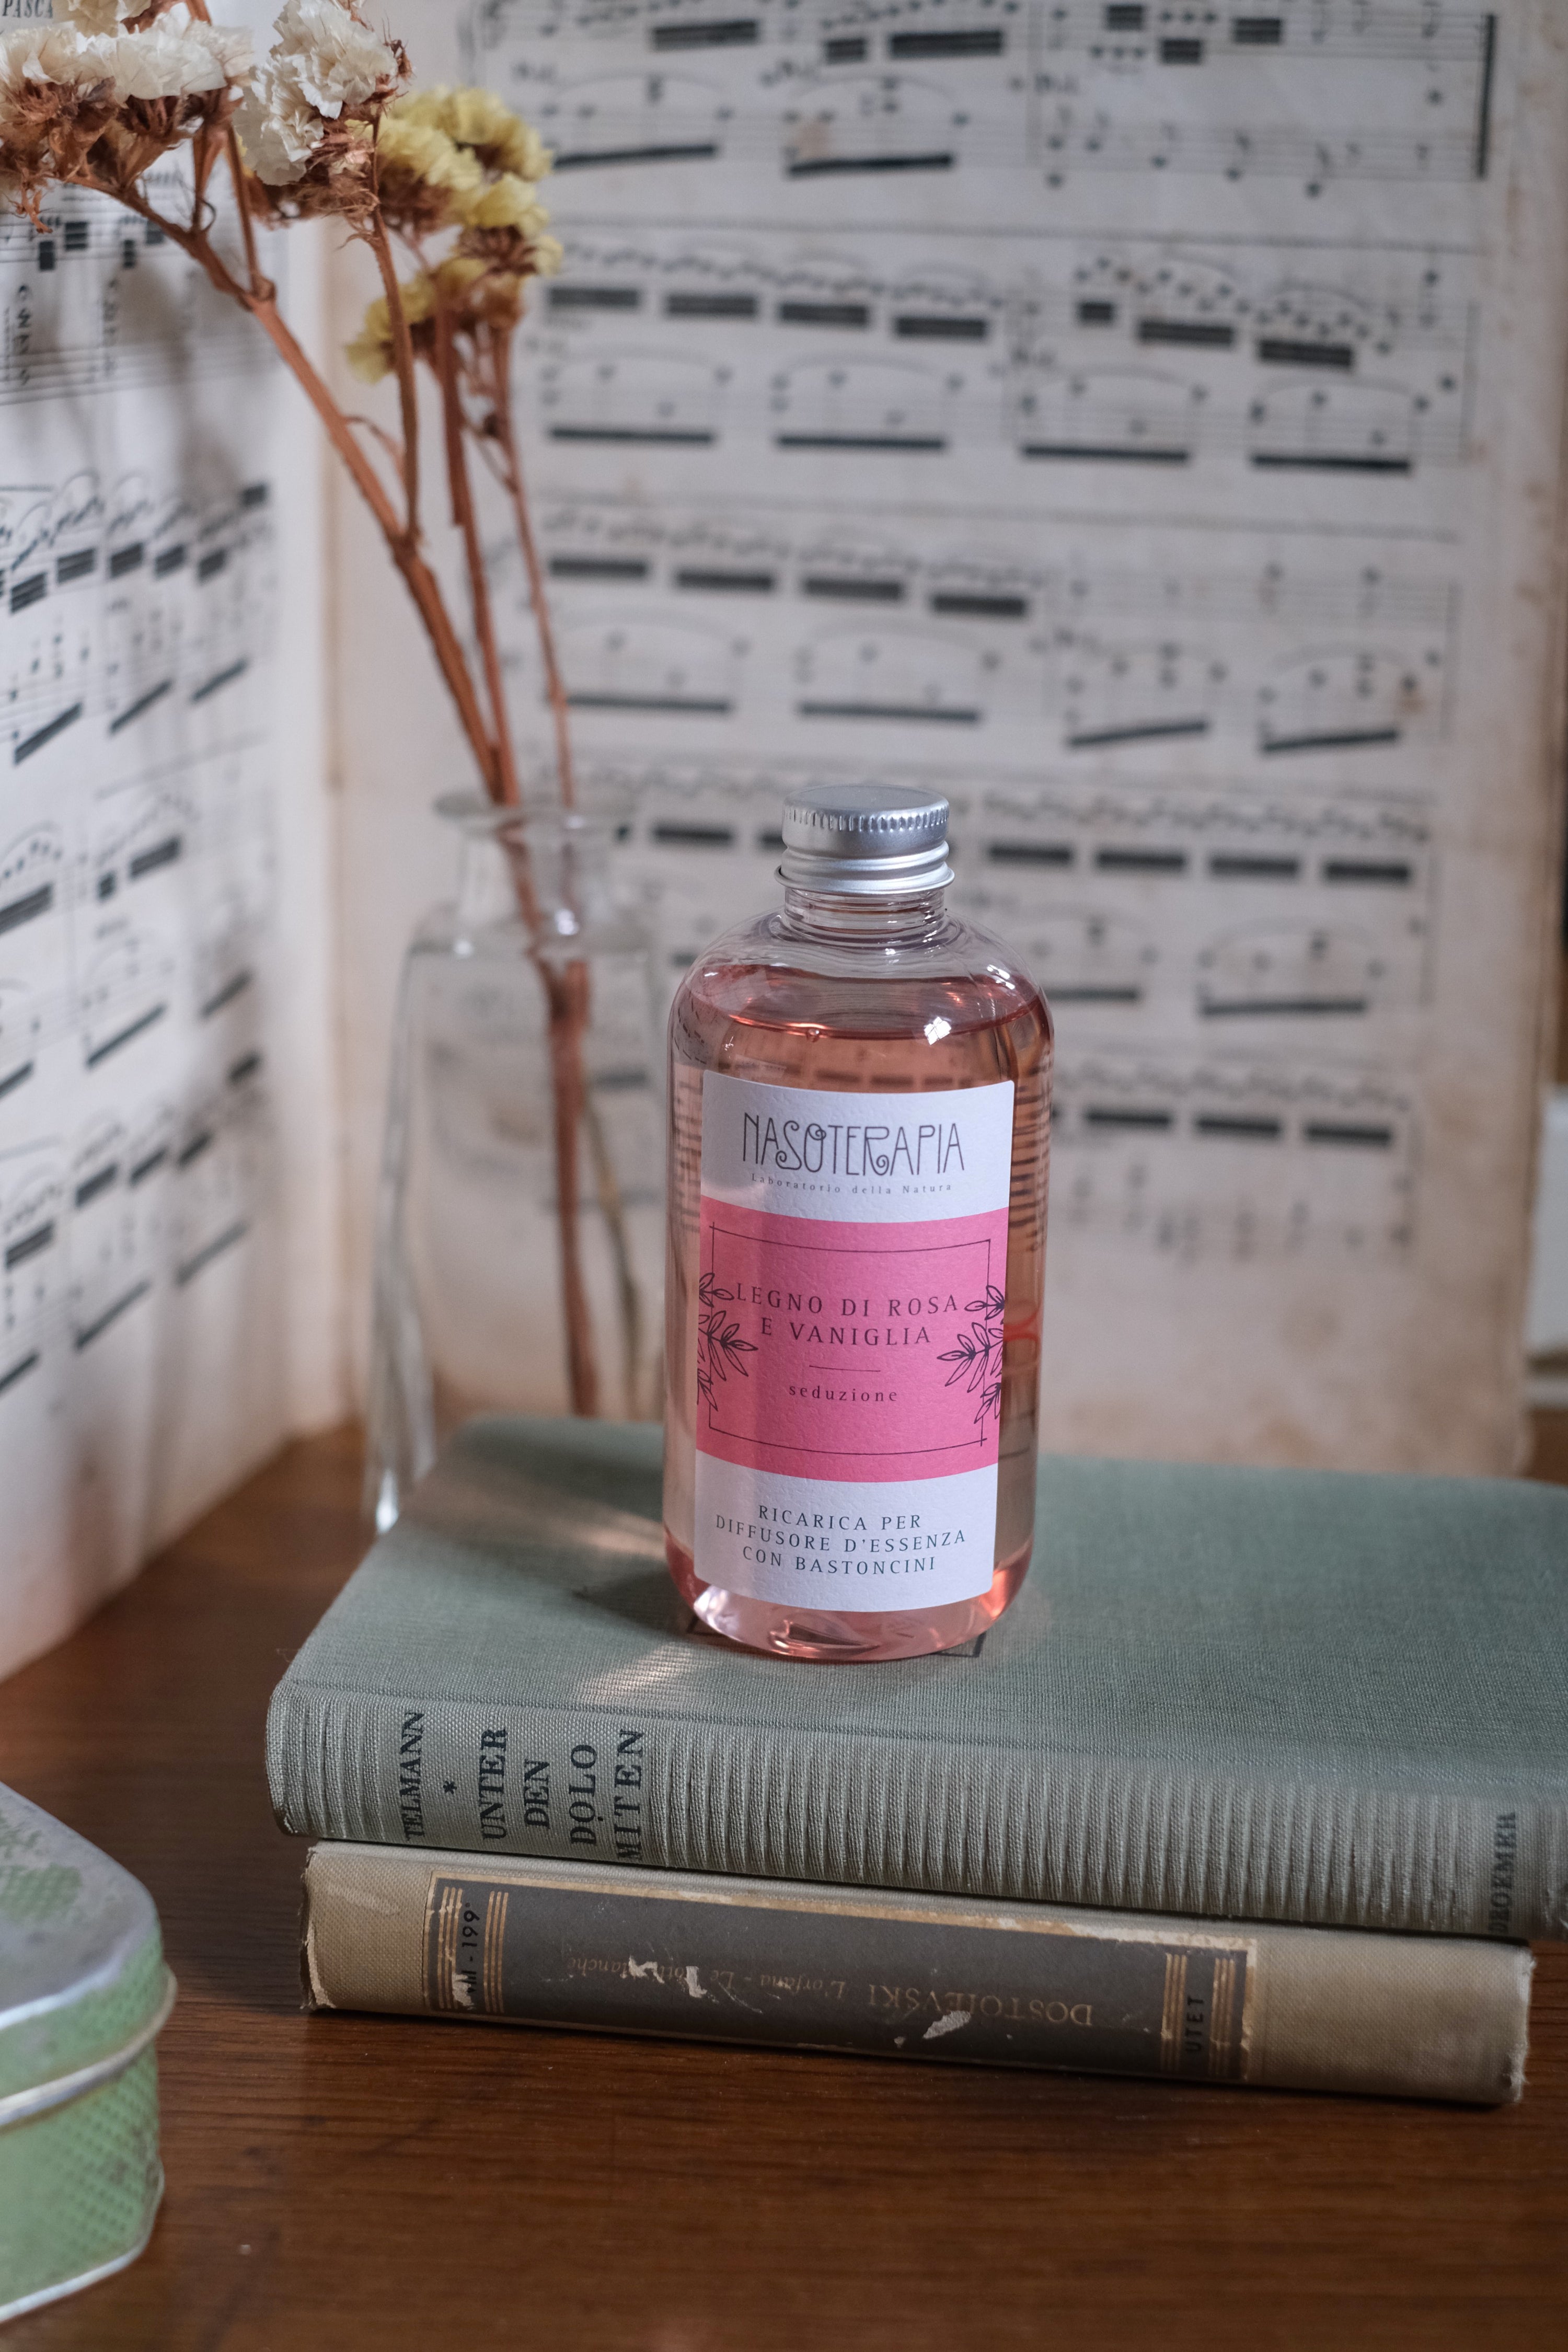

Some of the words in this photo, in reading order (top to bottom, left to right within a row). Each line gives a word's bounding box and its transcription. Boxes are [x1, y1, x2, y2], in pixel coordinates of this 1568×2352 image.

[743, 1112, 964, 1176] NASOTERAPIA
[752, 1173, 840, 1193] Laboratorio
[852, 1185, 891, 1194] della
[903, 1183, 951, 1194] Natura
[737, 1283, 823, 1314] LEGNO
[840, 1298, 870, 1317] DI
[888, 1295, 958, 1317] ROSA
[760, 1317, 773, 1336] E
[790, 1322, 931, 1346] VANIGLIA
[789, 1385, 897, 1402] seduzione
[716, 1515, 830, 1551] DIFFUSORE
[845, 1529, 965, 1552] D'ESSENZA
[758, 1505, 867, 1531] RICARICA
[881, 1515, 921, 1530] PER
[743, 1546, 782, 1567] CON
[795, 1556, 935, 1575] BASTONCINI
[399, 1709, 425, 1840] TELMANN
[479, 1727, 508, 1840] UNTER
[524, 1759, 550, 1829] DEN
[569, 1744, 597, 1845] DOLO
[614, 1729, 645, 1860] MITEN
[868, 1984, 1092, 2026] DOSTOIEVSKI
[1184, 1995, 1204, 2052] UTET
